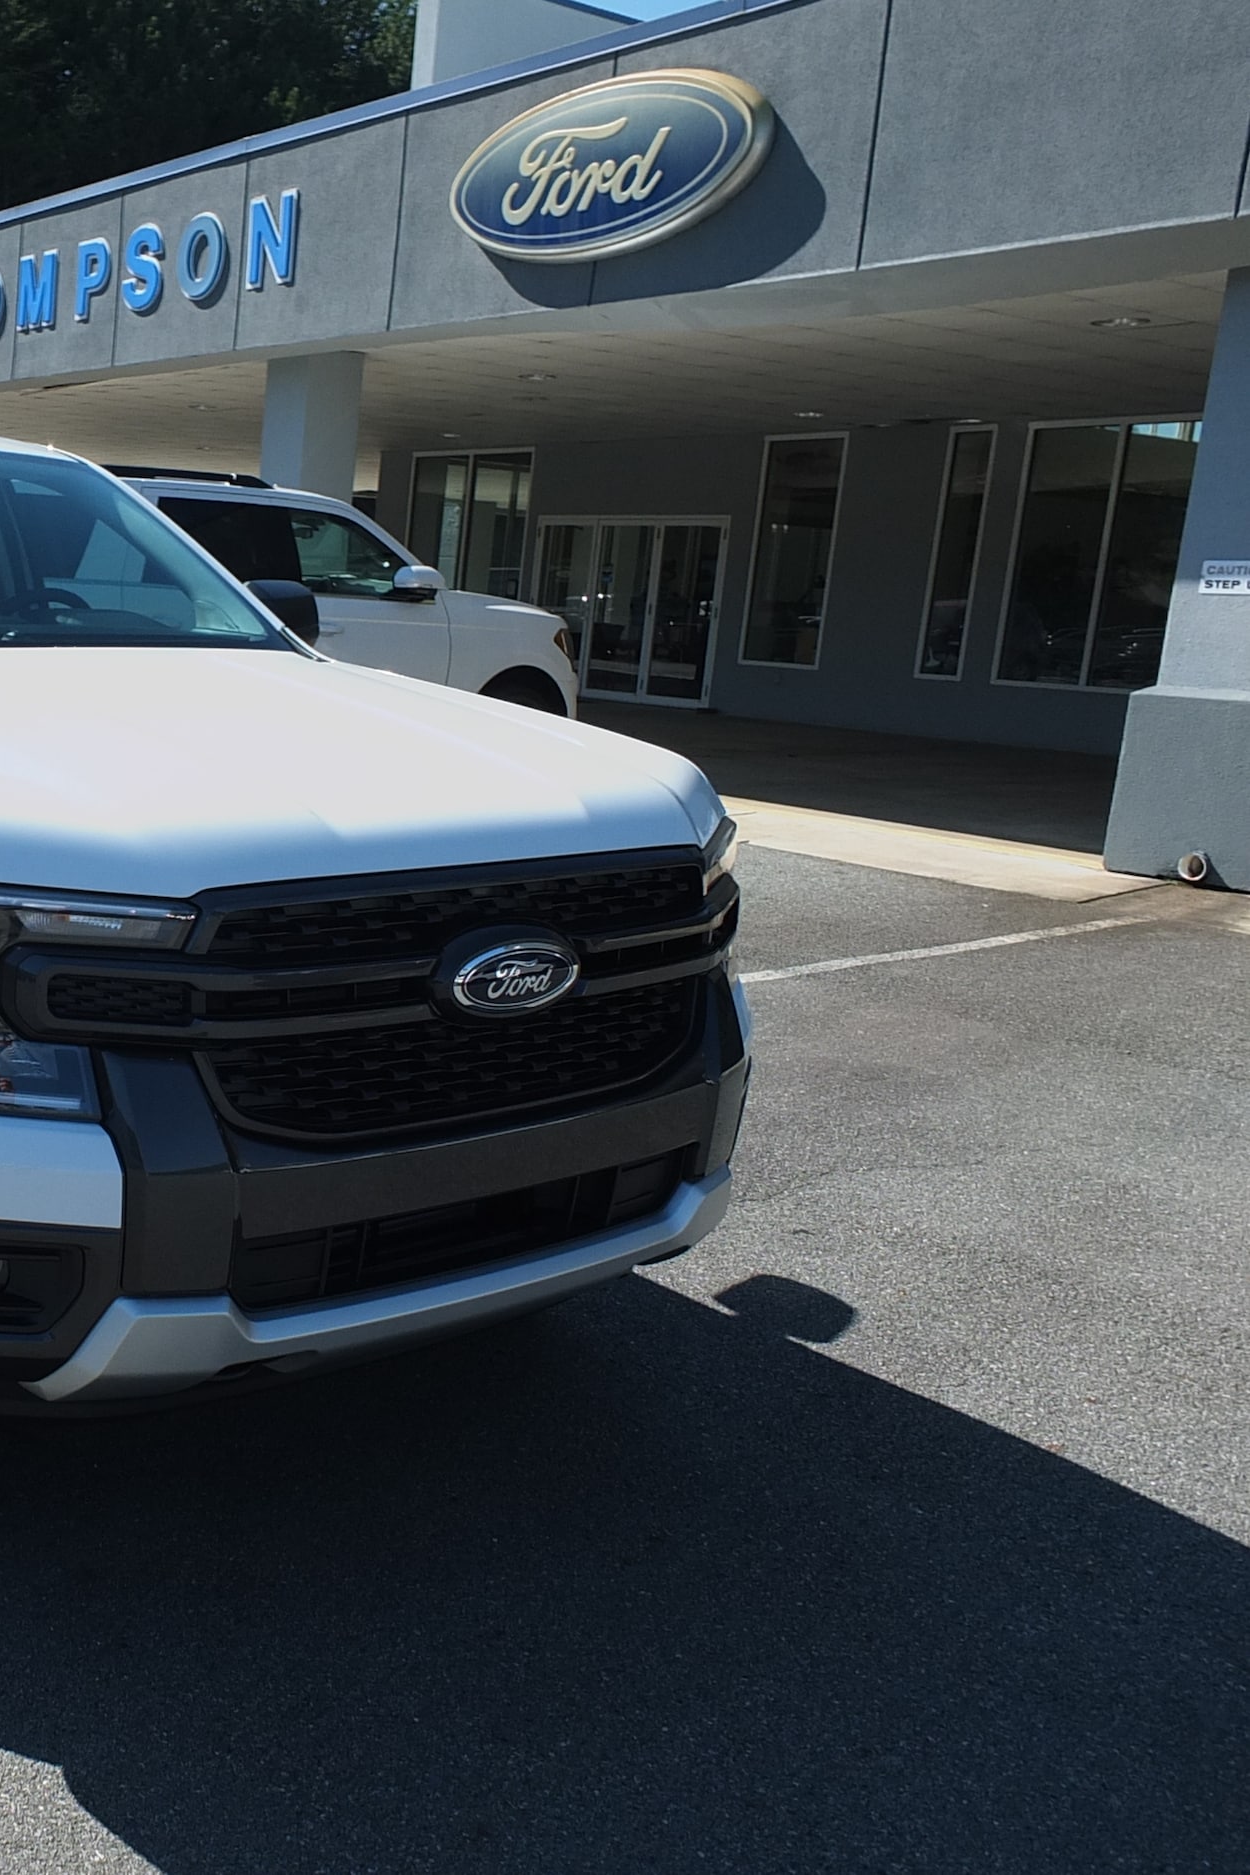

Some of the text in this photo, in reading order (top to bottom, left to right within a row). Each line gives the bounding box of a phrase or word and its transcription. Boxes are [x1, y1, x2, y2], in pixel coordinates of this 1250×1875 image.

[501, 116, 673, 225] Ford
[1206, 565, 1250, 575] CAUTI
[1204, 579, 1241, 589] STEP
[487, 959, 554, 999] Ford
